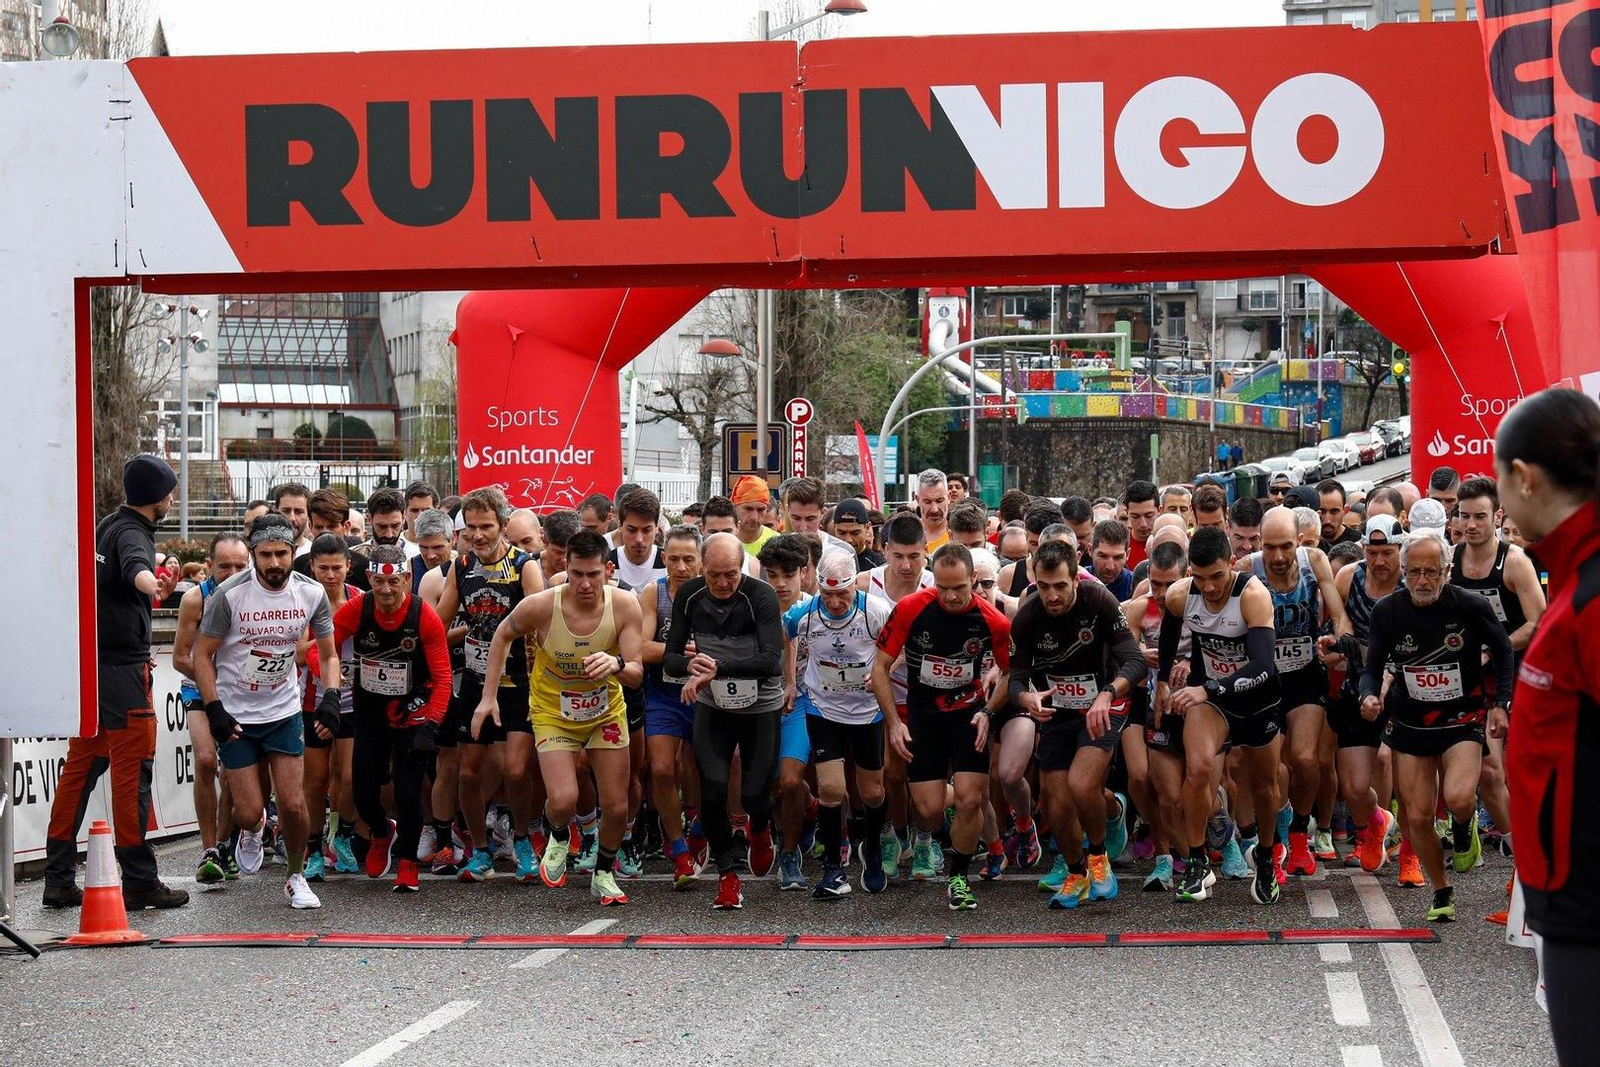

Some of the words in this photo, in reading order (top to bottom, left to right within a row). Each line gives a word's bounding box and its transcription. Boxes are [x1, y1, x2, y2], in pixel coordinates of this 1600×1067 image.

[487, 406, 559, 432] Sports
[791, 403, 808, 421] P
[482, 445, 595, 466] Santander
[239, 612, 249, 621] VI
[253, 609, 306, 621] CARREIRA
[239, 626, 285, 635] CALVARIO
[1275, 646, 1302, 659] 145
[257, 660, 285, 672] 222
[932, 663, 964, 678] 552
[378, 669, 387, 681] 6
[838, 670, 846, 681] 1
[1416, 673, 1450, 688] 504
[727, 682, 738, 695] 8
[1055, 683, 1087, 696] 596
[571, 695, 601, 710] 540
[166, 692, 189, 732] CO
[176, 745, 195, 785] DE
[13, 761, 36, 806] DE
